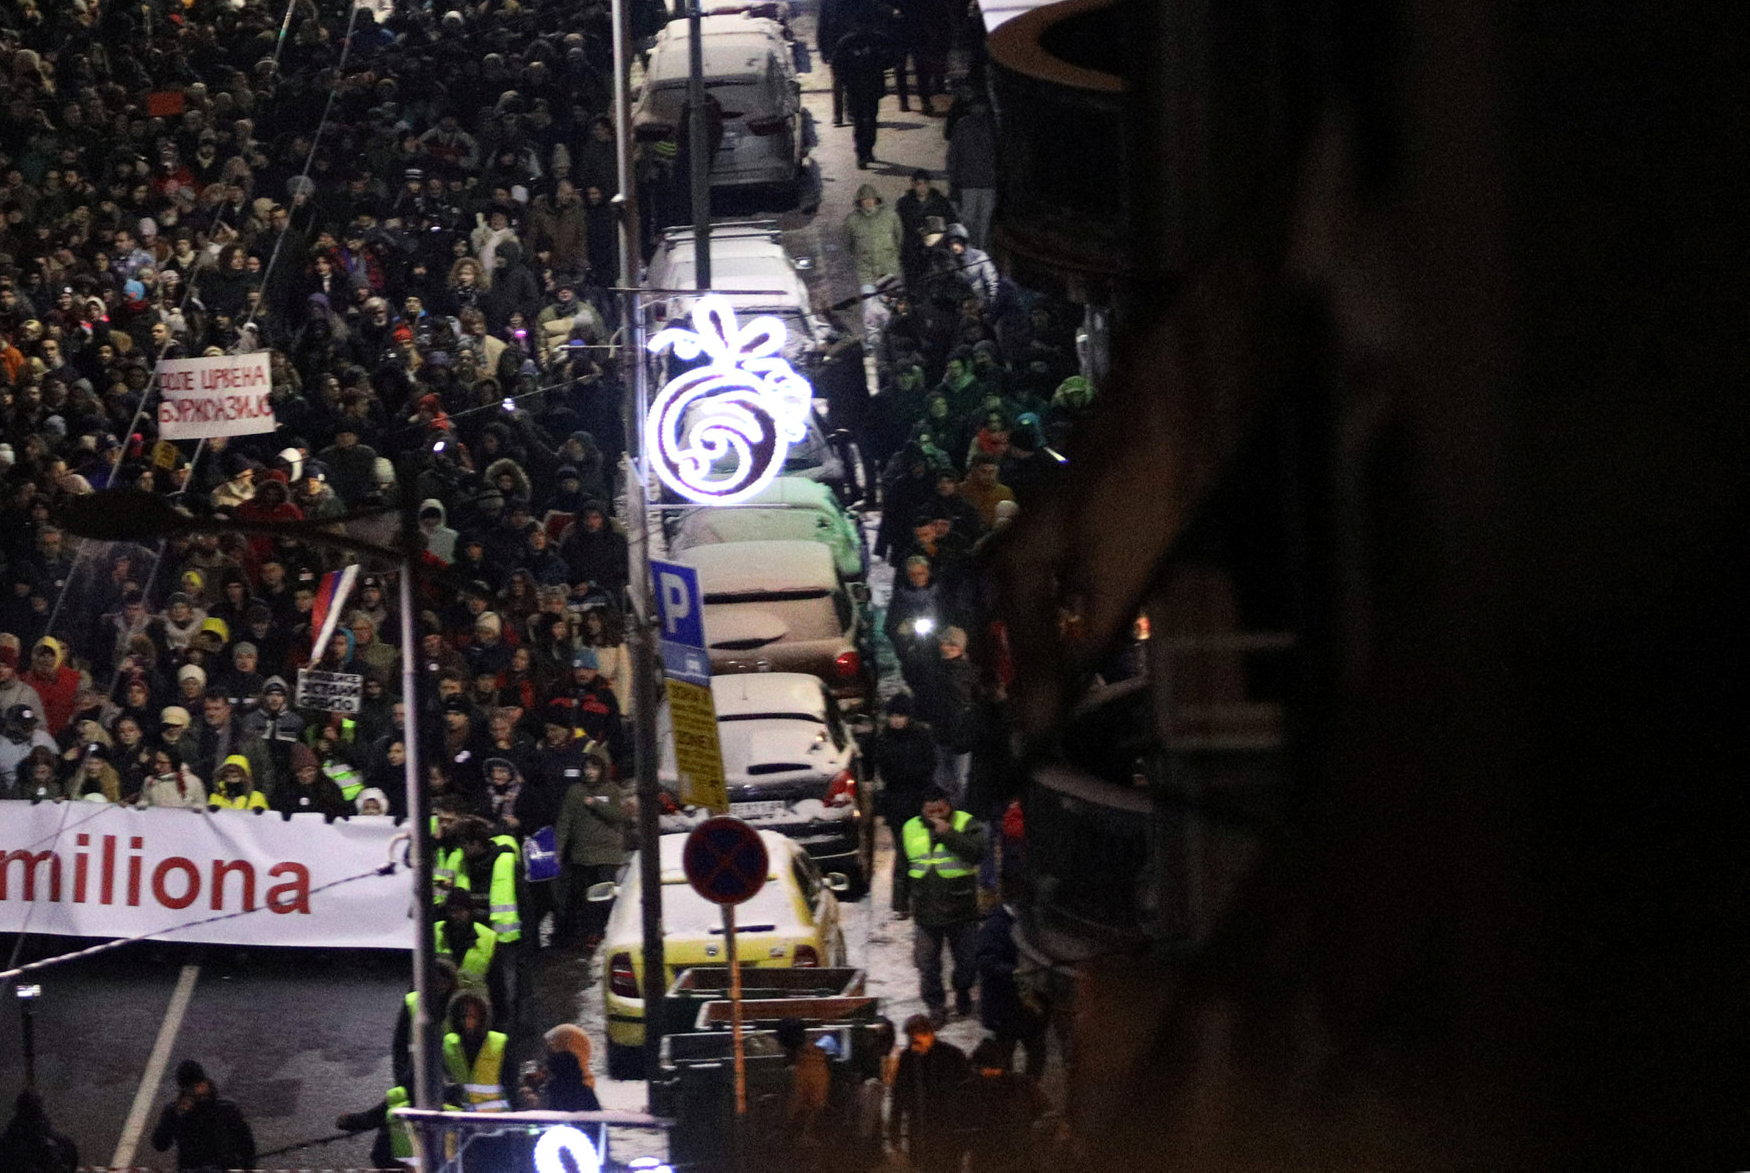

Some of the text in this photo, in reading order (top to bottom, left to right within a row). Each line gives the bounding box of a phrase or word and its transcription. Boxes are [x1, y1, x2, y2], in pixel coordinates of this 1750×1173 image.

[201, 365, 268, 390] ЦРВЕНА
[159, 392, 274, 424] БУРЖОАЗИЈО
[660, 571, 691, 634] P
